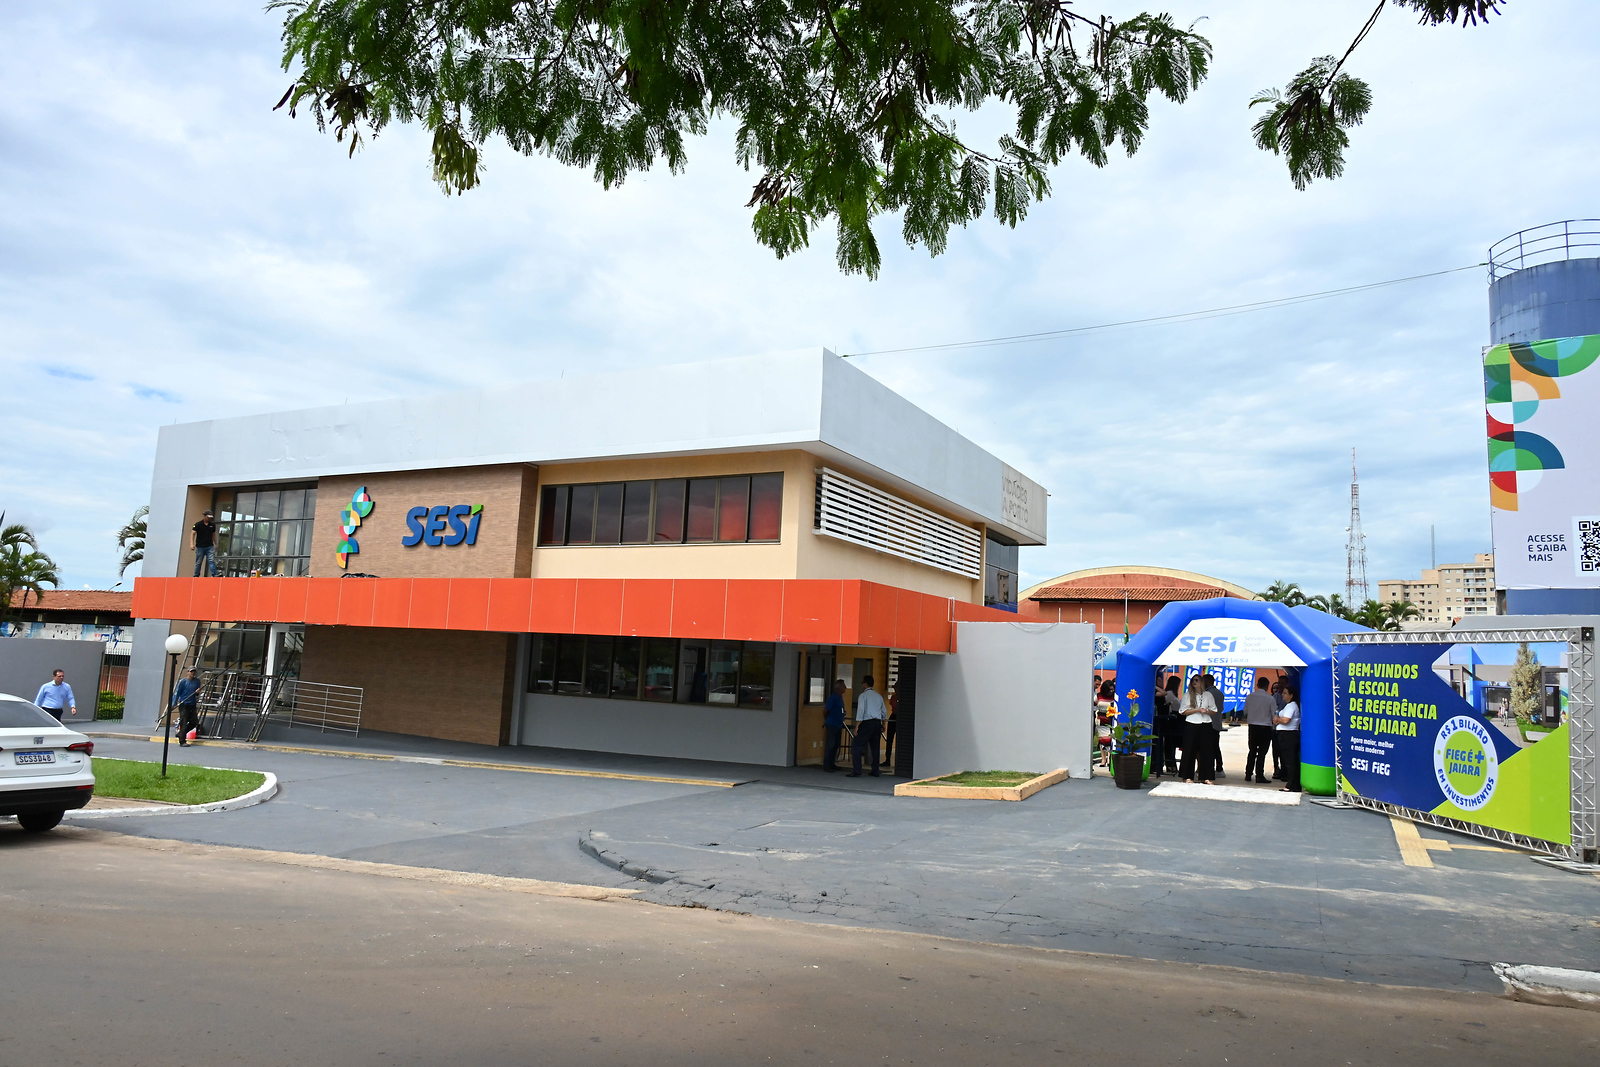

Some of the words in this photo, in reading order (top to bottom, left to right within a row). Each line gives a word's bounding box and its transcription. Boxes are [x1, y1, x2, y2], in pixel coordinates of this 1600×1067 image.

[1527, 534, 1565, 542] ACESSE
[1528, 544, 1534, 552] E
[1536, 544, 1567, 552] SAIBA
[1528, 554, 1553, 562] MAIS
[1348, 662, 1419, 680] BEM-VINDOS
[1348, 677, 1356, 694] À
[1358, 680, 1399, 697] ESCOLA
[1349, 697, 1363, 712] DE
[1365, 698, 1437, 720] REFERÊNCIA
[1350, 715, 1373, 731] SESI
[1374, 718, 1417, 737] JAIARA
[1459, 719, 1489, 745] BILHÃO
[1350, 736, 1363, 744] Agora
[1378, 741, 1394, 749] melhor
[19, 754, 52, 763] SCS3D48
[1365, 747, 1385, 756] moderna
[1449, 762, 1480, 777] JAIARA
[1437, 768, 1446, 783] EM
[1444, 777, 1495, 807] INVESTIMENTOS
